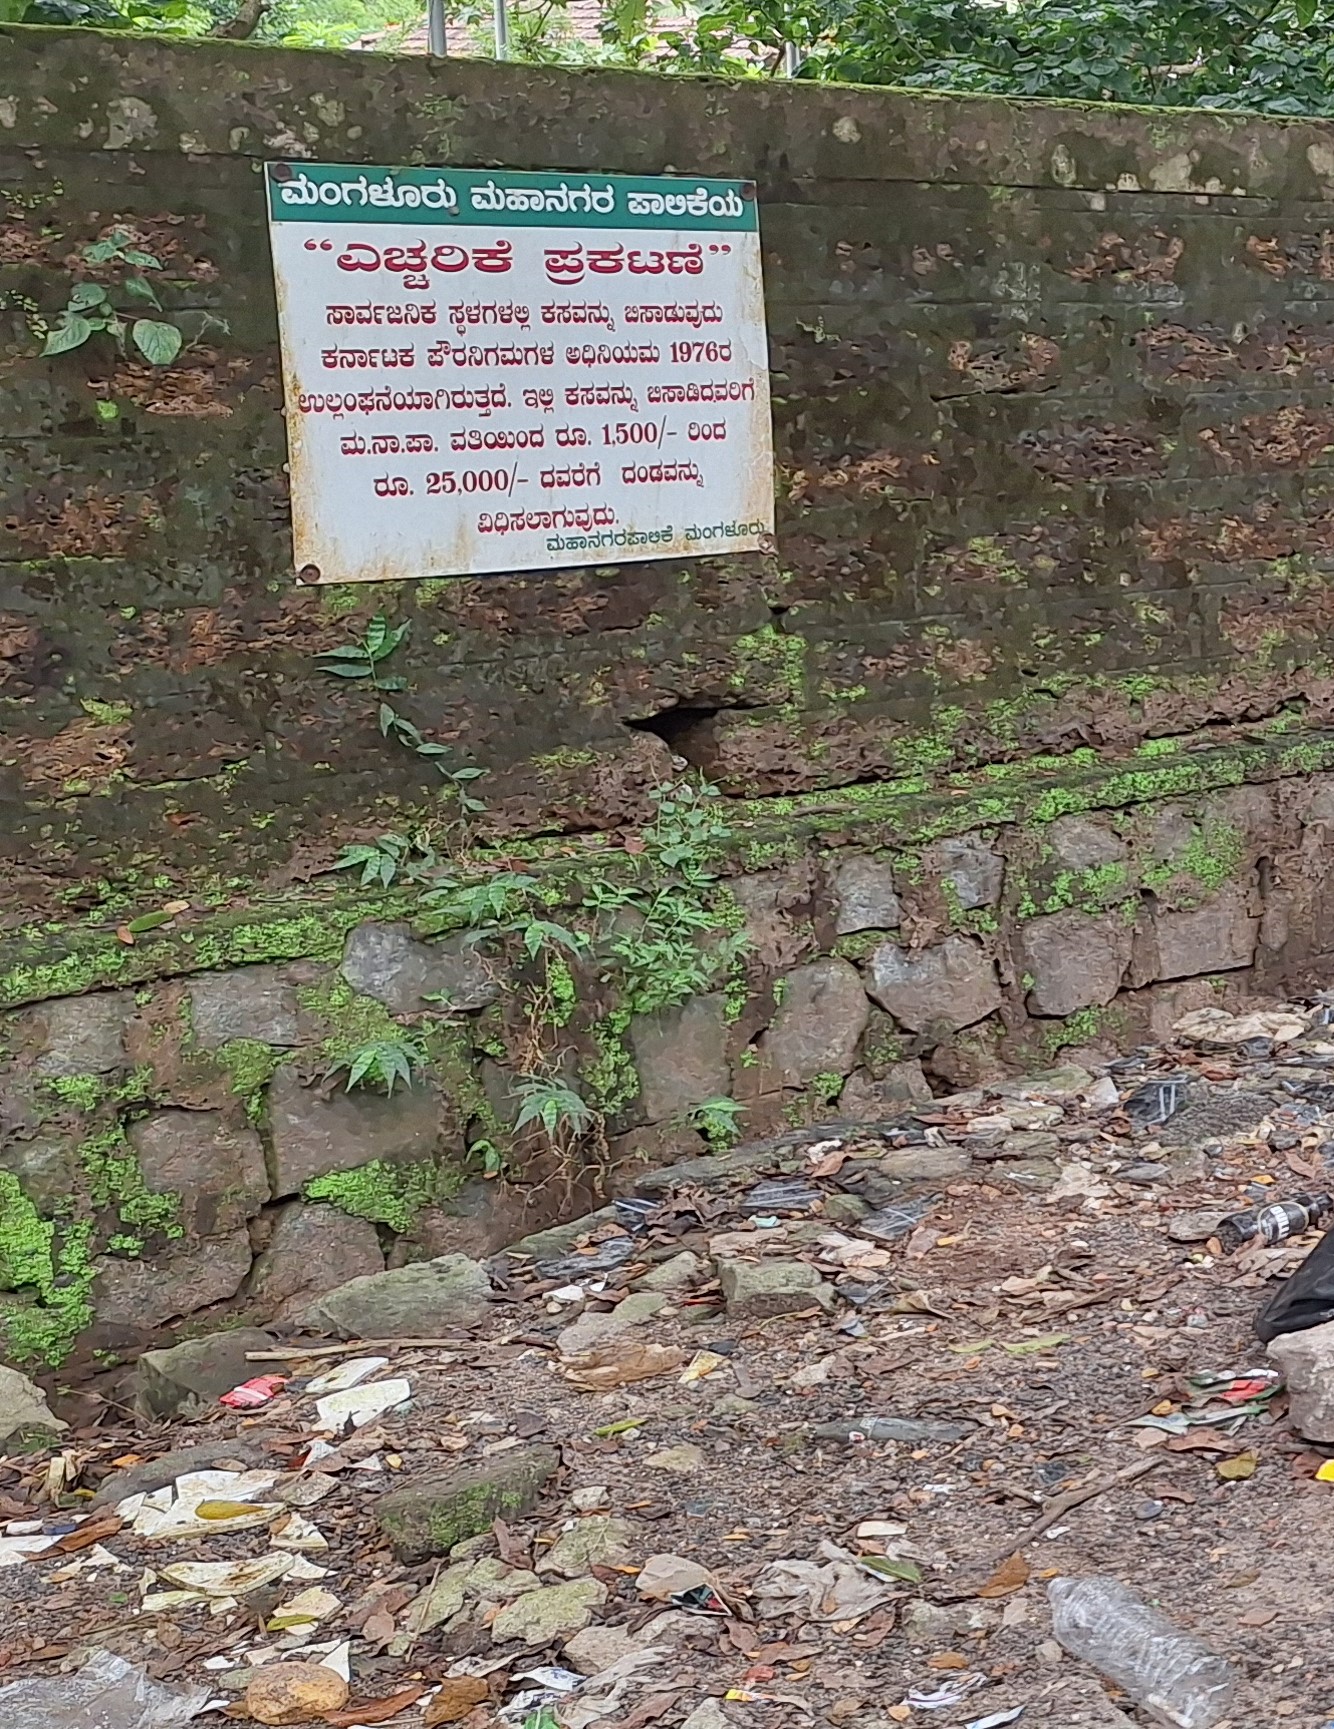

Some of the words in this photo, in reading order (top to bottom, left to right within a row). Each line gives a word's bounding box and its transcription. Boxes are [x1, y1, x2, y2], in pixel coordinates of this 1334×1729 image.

[278, 173, 458, 209] ಮಂಗಳೂರು
[470, 180, 615, 214] ಮಹಾನಗರ
[627, 187, 744, 218] ಪಾಲಿಕೆಯ
[326, 299, 437, 326] ಸಾರ್ವಜನಿಕ
[448, 299, 531, 336] ಸ್ಥಳಗಳಲ್ಲಿ
[541, 299, 615, 332] ಕಸವನ್ನು
[624, 299, 723, 328] ಬಿಸಾಡುವುದು
[321, 343, 415, 368] ಕರ್ನಾಟಕ
[427, 340, 554, 367] ಪೌರನಿಗಮಗಳ
[566, 340, 660, 368] ಅಧಿನಿಯಮ
[670, 338, 732, 363] 1976ರ
[522, 387, 554, 413] ಇಲ್ಲಿ
[565, 380, 639, 412] ಕಸವನ್ನು
[450, 423, 545, 451] ವತಿಯಿಂದ
[555, 422, 592, 447] ರೂ.
[602, 415, 677, 450] 1,500/-
[688, 417, 727, 441] ರಿಂದ
[373, 472, 414, 497] ರೂ.
[426, 461, 529, 497] 25,000/-
[540, 462, 601, 488] ದವರೆಗೆ
[622, 457, 705, 487] ದಂಡವನ್ನು
[546, 525, 674, 551] ಮಹಾನಗರಪಾಲಿಕೆ
[686, 518, 765, 541] ಮಂಗಳೂರು
